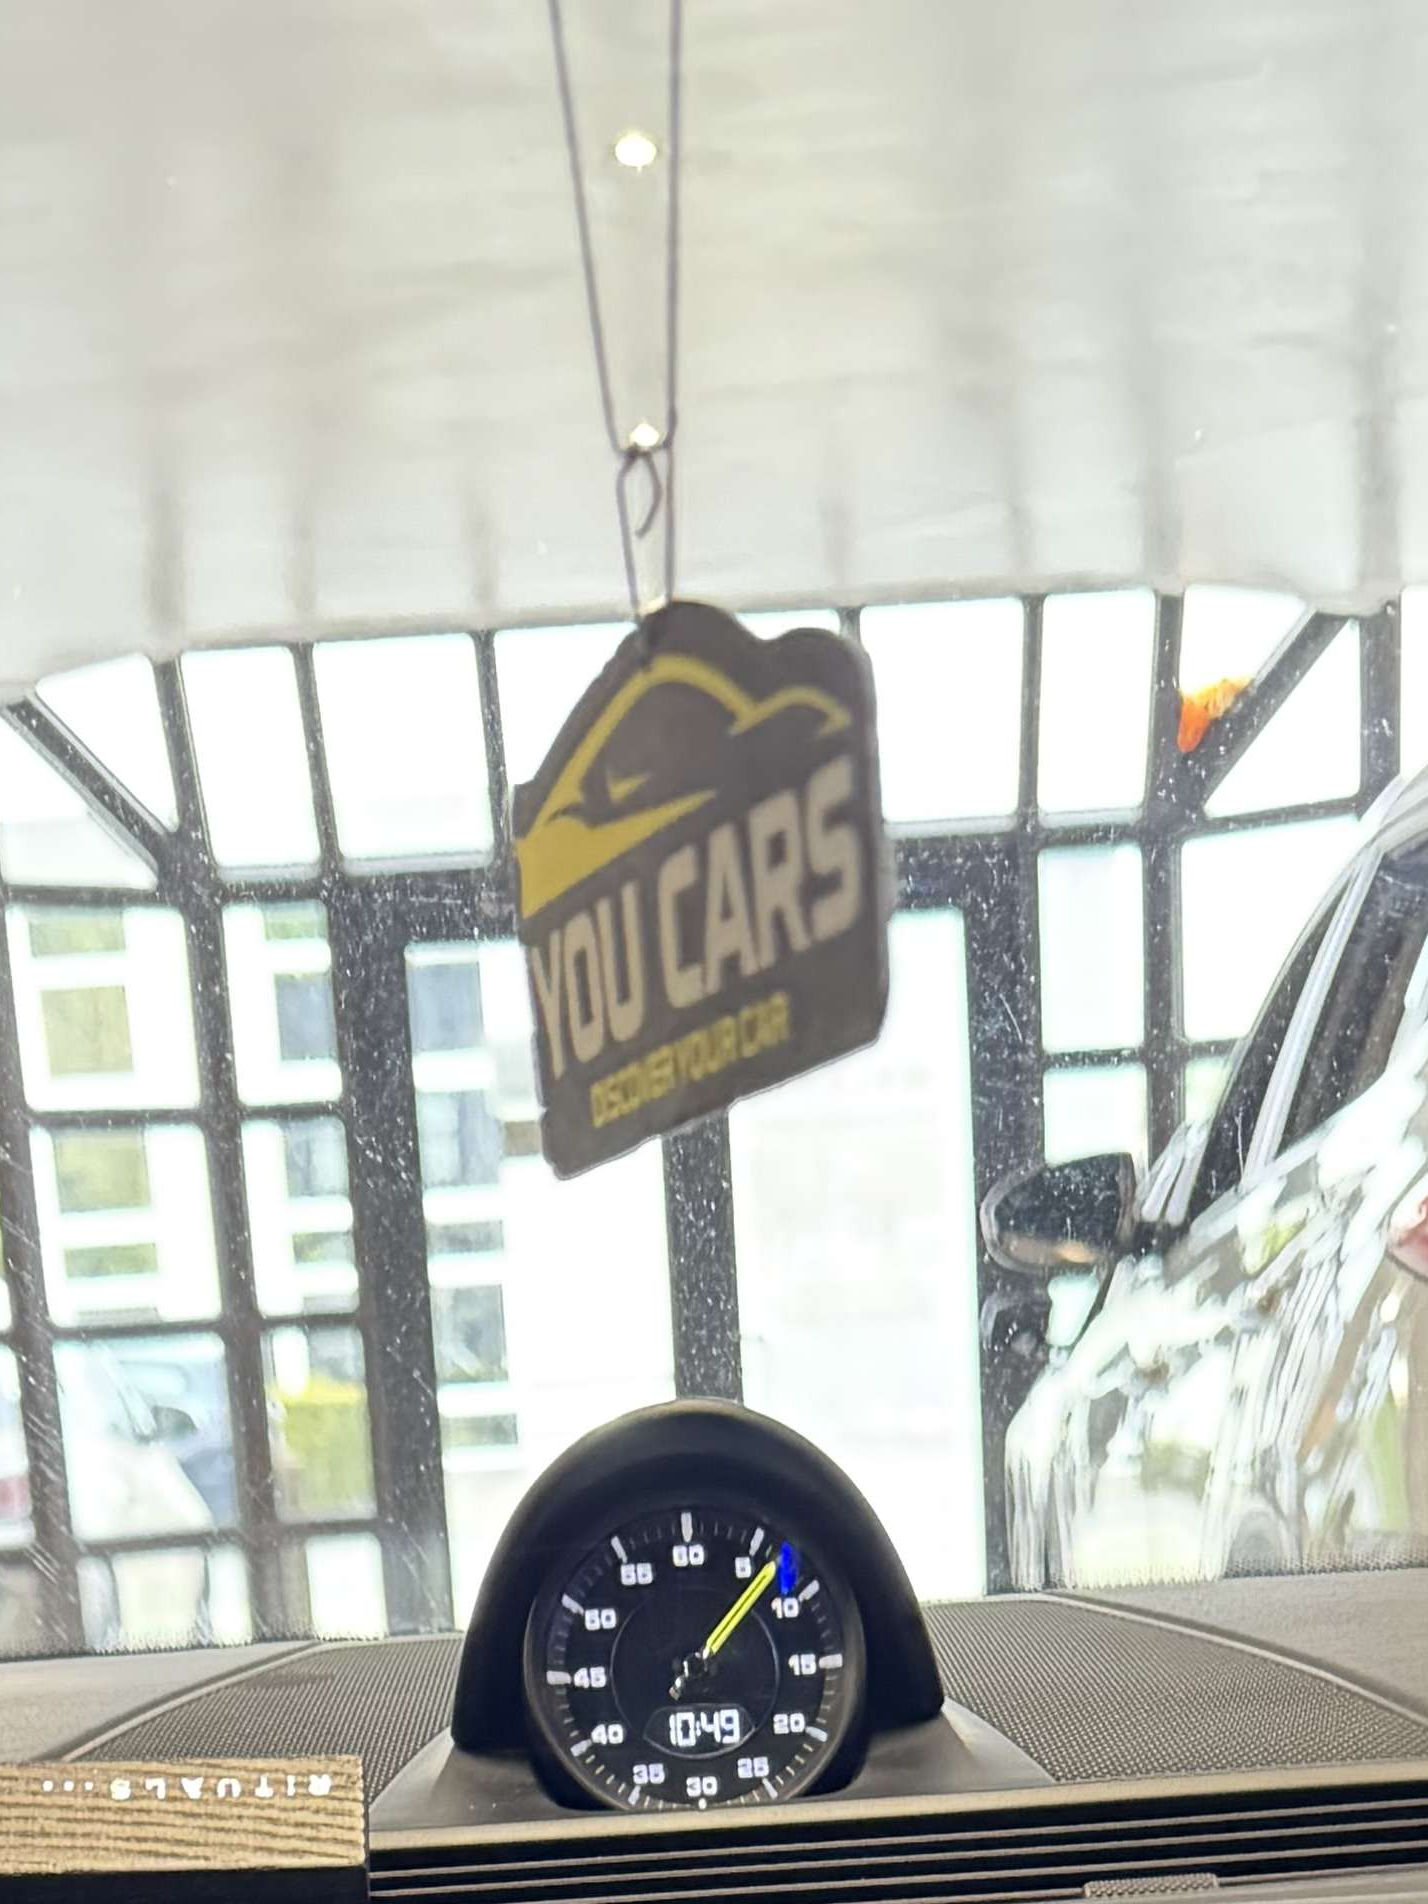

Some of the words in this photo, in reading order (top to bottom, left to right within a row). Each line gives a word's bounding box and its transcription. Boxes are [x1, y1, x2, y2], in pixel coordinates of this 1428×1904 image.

[532, 880, 646, 1080] YOU
[657, 754, 863, 1008] CARS
[738, 992, 790, 1058] CAR
[771, 1597, 799, 1618] 10
[789, 1654, 816, 1674] 15
[573, 1667, 606, 1688] 45
[591, 1724, 624, 1745] 40
[669, 1709, 741, 1747] 10:49
[773, 1714, 805, 1734] 20
[633, 1763, 664, 1784] 35
[737, 1757, 769, 1778] 25
[686, 1776, 718, 1797] 30
